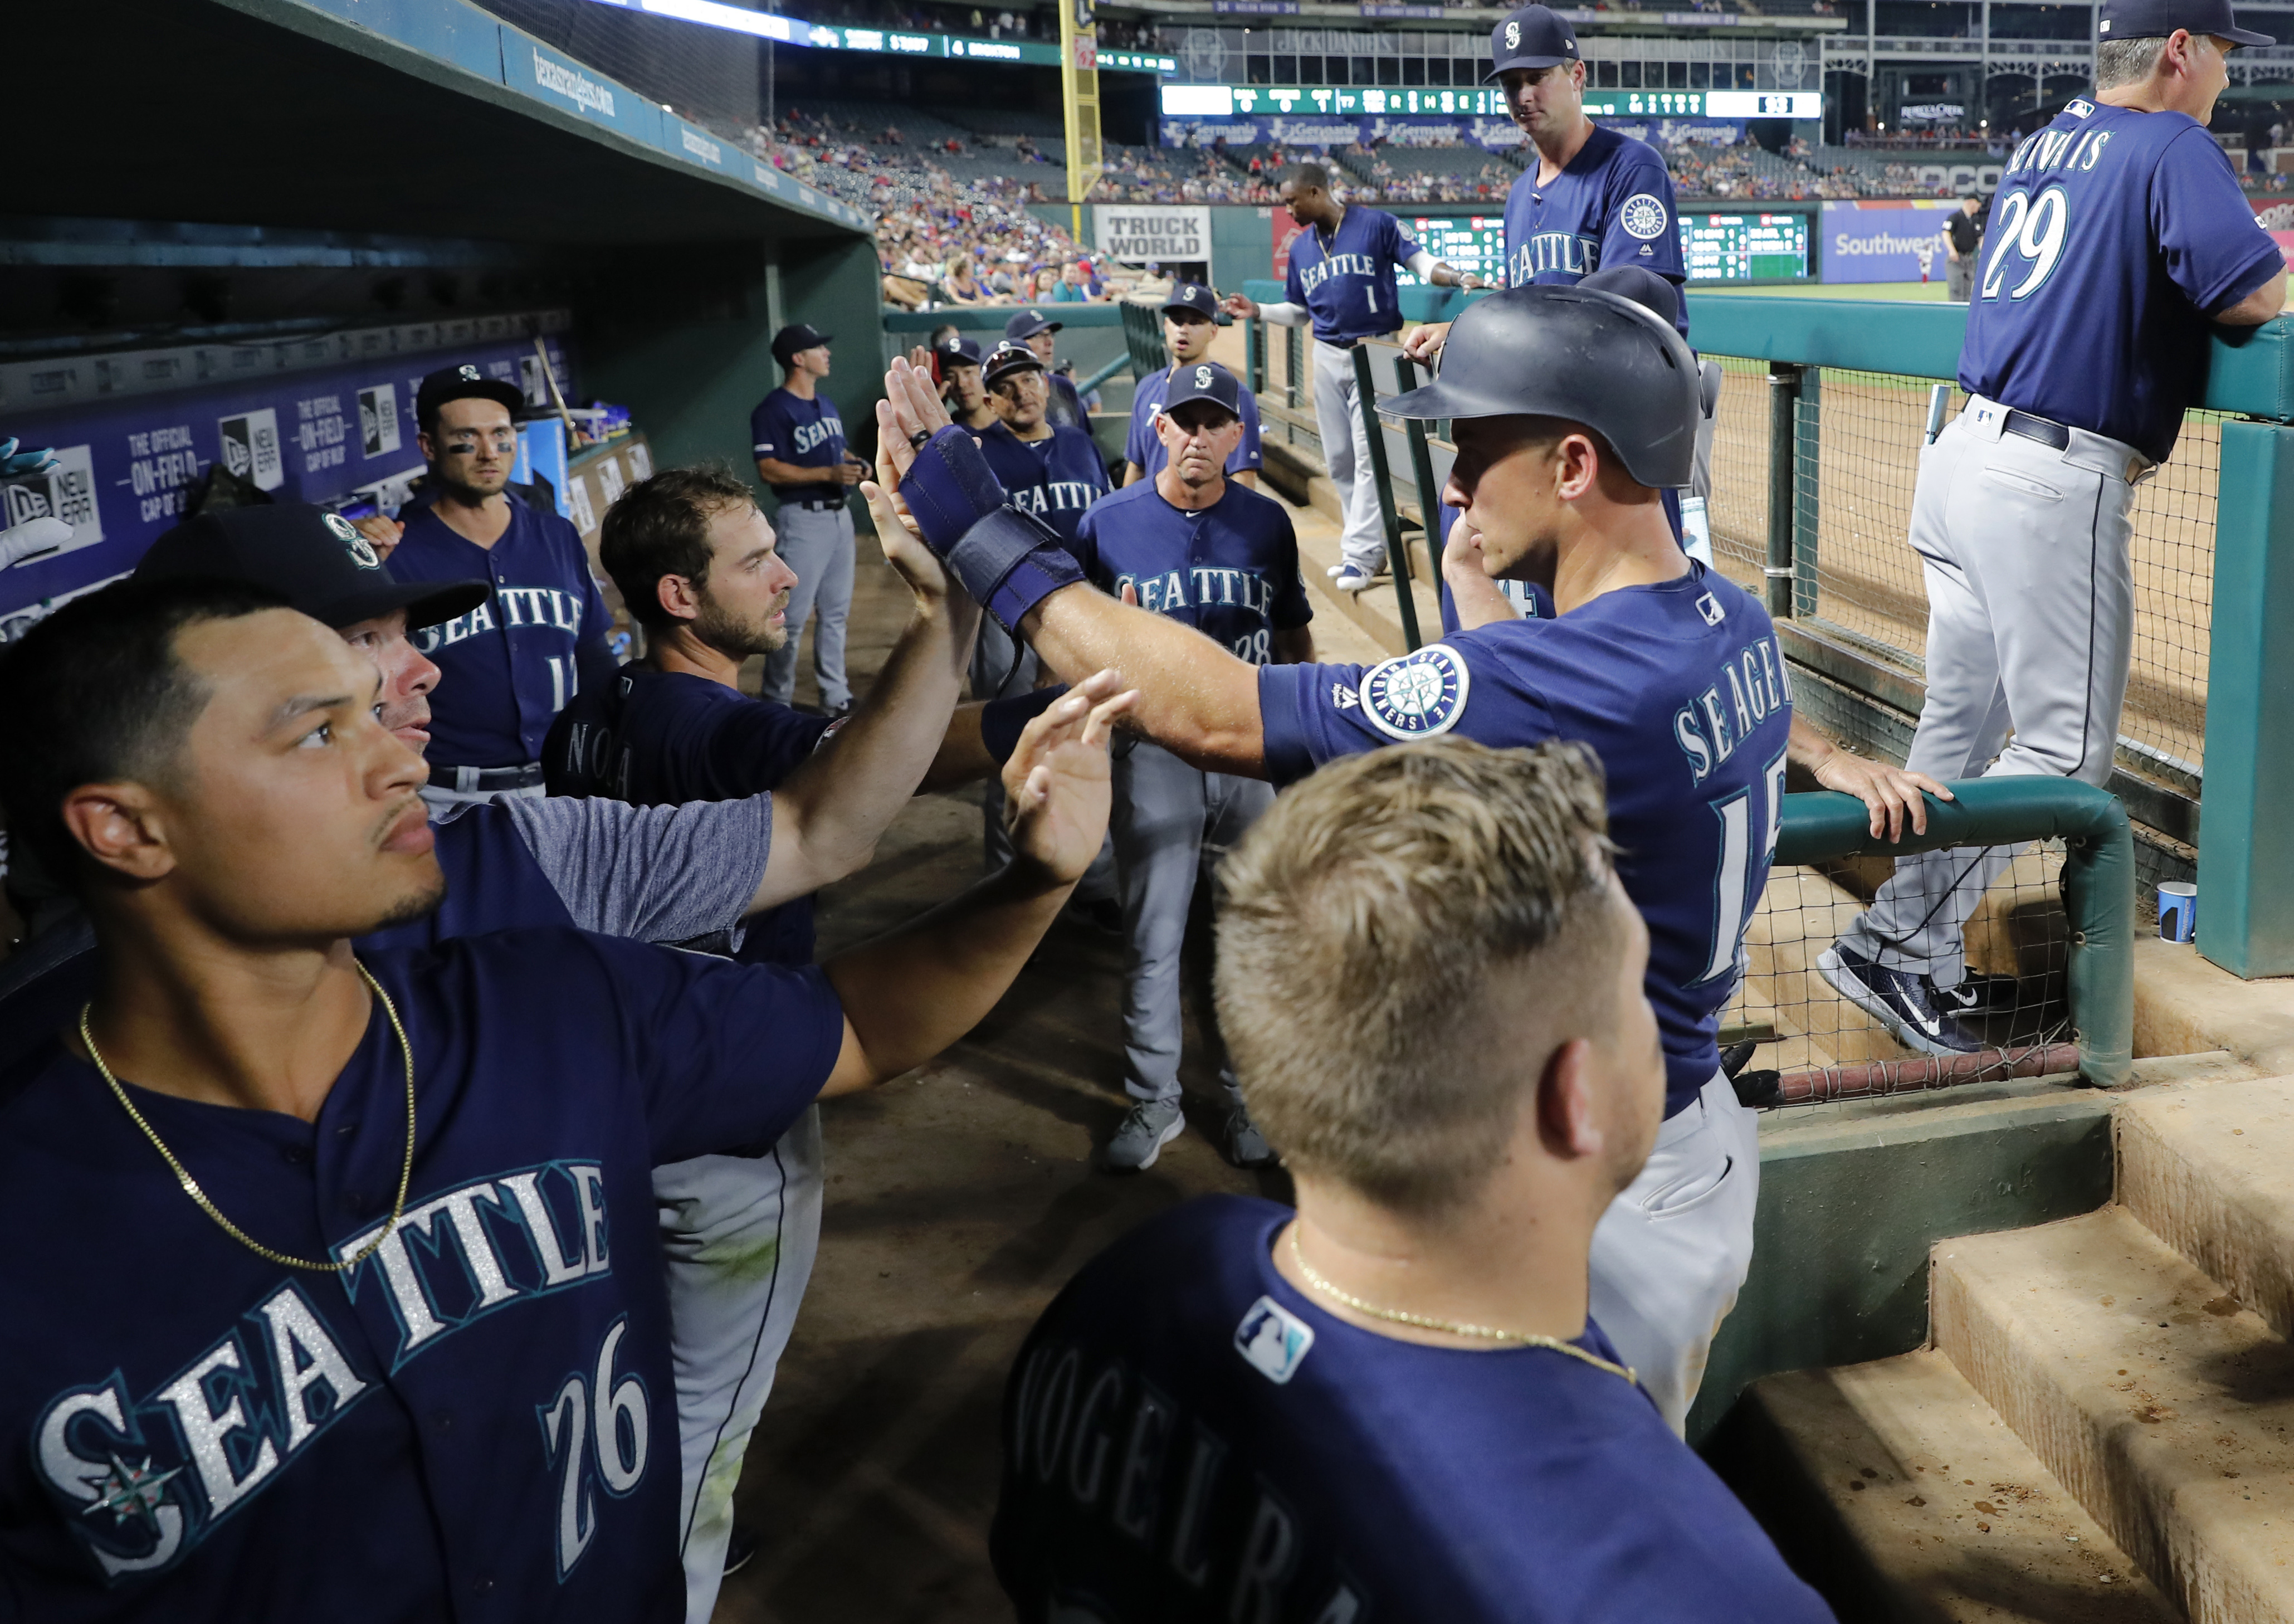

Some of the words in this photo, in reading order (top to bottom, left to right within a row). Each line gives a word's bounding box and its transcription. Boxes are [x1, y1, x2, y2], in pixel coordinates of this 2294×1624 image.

[1108, 217, 1199, 235] TRUCK
[1626, 198, 1661, 214] SEATTLE
[1108, 237, 1200, 255] WORLD
[1509, 230, 1601, 289] EATTLE
[1836, 232, 1942, 256] Southwest
[1981, 184, 2071, 303] 29
[1300, 253, 1376, 298] SEATTLE
[1366, 285, 1379, 314] 1
[128, 432, 151, 457] THE
[57, 469, 88, 499] NEW
[131, 450, 198, 496] ON-FIELD
[1004, 481, 1102, 514] EATTL
[1372, 664, 1418, 730] MARINERS
[1418, 652, 1457, 720] SEATTLE
[567, 723, 631, 799] NOA
[2181, 898, 2191, 940] POWERADE
[31, 1159, 613, 1588] SEATTLE
[536, 1311, 652, 1585] 26
